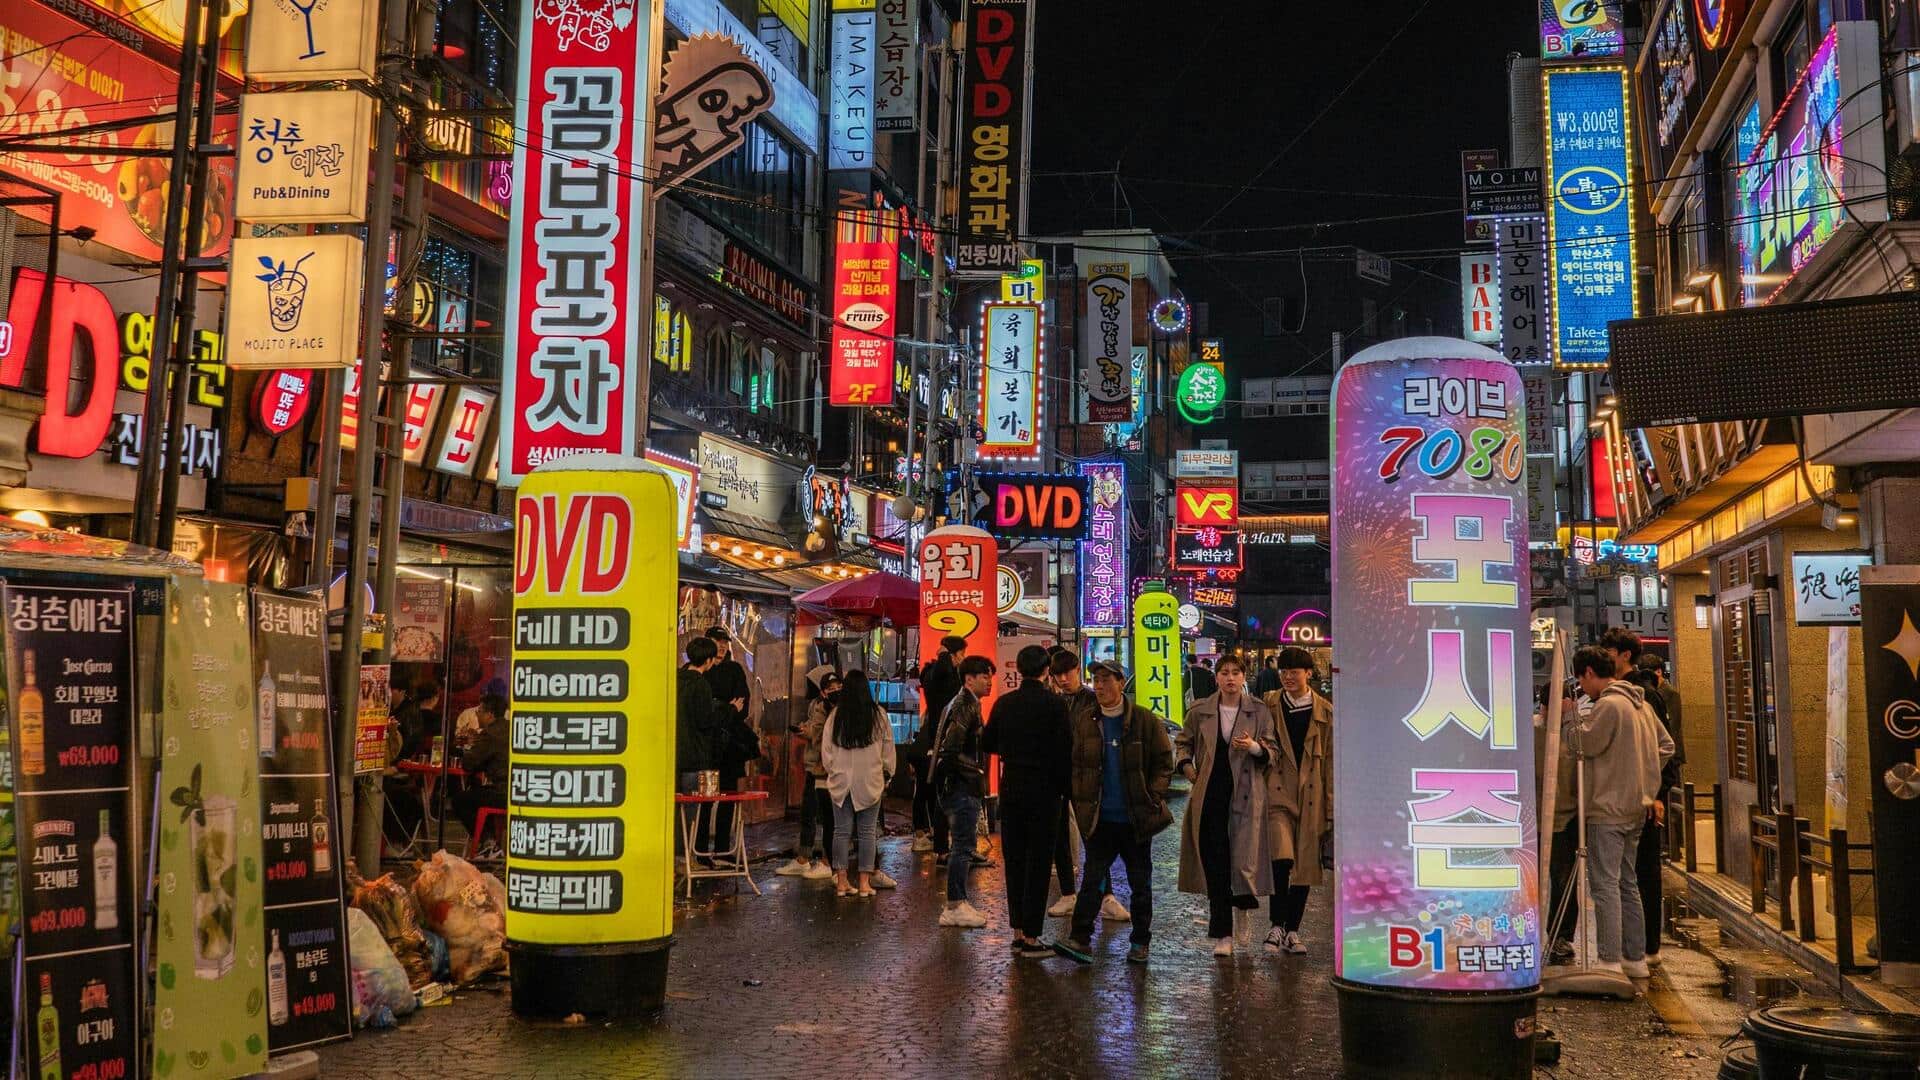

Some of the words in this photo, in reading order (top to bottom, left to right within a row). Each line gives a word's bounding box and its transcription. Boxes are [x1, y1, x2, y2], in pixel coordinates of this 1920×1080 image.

[1545, 34, 1573, 53] B1
[973, 9, 1016, 117] DVD
[90, 69, 124, 101] 이야기
[249, 117, 304, 163] 청춘
[290, 143, 345, 177] 예찬
[252, 186, 331, 200] Pub&Dining
[968, 125, 1012, 234] 영화관
[533, 73, 617, 430] 꼼보포차
[959, 244, 1018, 266] 진동의자
[864, 284, 890, 296] BAR
[1470, 263, 1493, 331] BAR
[1508, 224, 1537, 339] 민호헤어
[244, 339, 286, 351] MOJITO
[289, 338, 325, 349] PLACE
[1202, 347, 1220, 360] 24
[848, 384, 877, 402] 2F
[998, 313, 1022, 436] 육회본가
[1404, 378, 1507, 419] 라이브
[1379, 427, 1523, 482] 7080
[996, 483, 1082, 529] DVD
[1183, 492, 1233, 520] VR
[515, 494, 634, 598] DVD
[924, 540, 983, 588] 육회
[1181, 548, 1235, 562] 노래연습장
[11, 594, 126, 633] 청춘예찬
[258, 600, 319, 638] 청춘예찬
[516, 615, 561, 645] Full
[569, 615, 619, 645] HD
[54, 685, 80, 703] 호세
[514, 667, 620, 697] Cinema
[1147, 635, 1170, 718] 마사지
[1401, 492, 1520, 890] 포시즌
[511, 768, 616, 804] 진동의자
[32, 844, 79, 865] 스미노프
[511, 820, 615, 857] 영화+팝콘+커피
[509, 872, 613, 911] 무료셀프바
[1387, 923, 1445, 972] B1
[1457, 943, 1535, 973] 단란주점
[77, 1018, 115, 1045] 아구아
